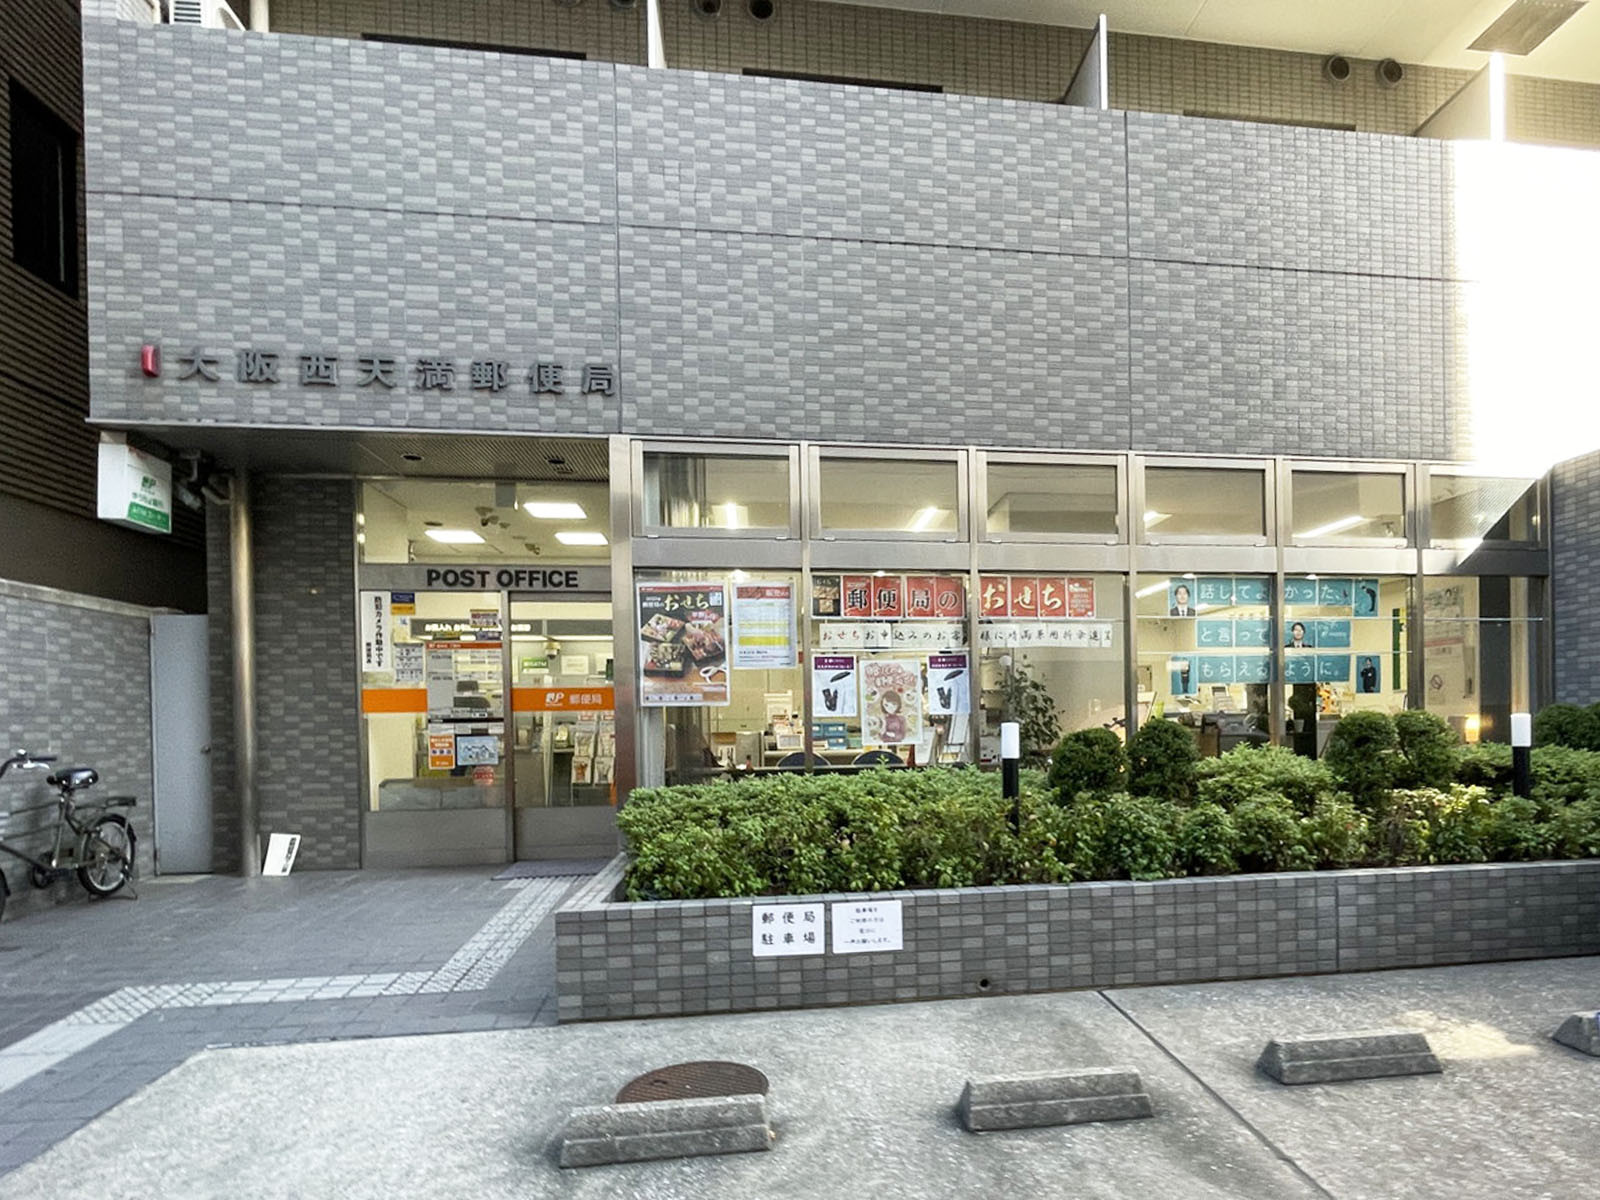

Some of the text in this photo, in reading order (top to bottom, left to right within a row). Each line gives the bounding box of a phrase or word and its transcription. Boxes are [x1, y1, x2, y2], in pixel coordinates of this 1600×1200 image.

[180, 350, 616, 396] 大阪西天満郵便局
[426, 569, 579, 588] POST OFFICE
[664, 592, 709, 611] おせち
[1201, 626, 1267, 642] と言って
[761, 911, 815, 925] 郵便局
[761, 931, 815, 946] 駐車場
